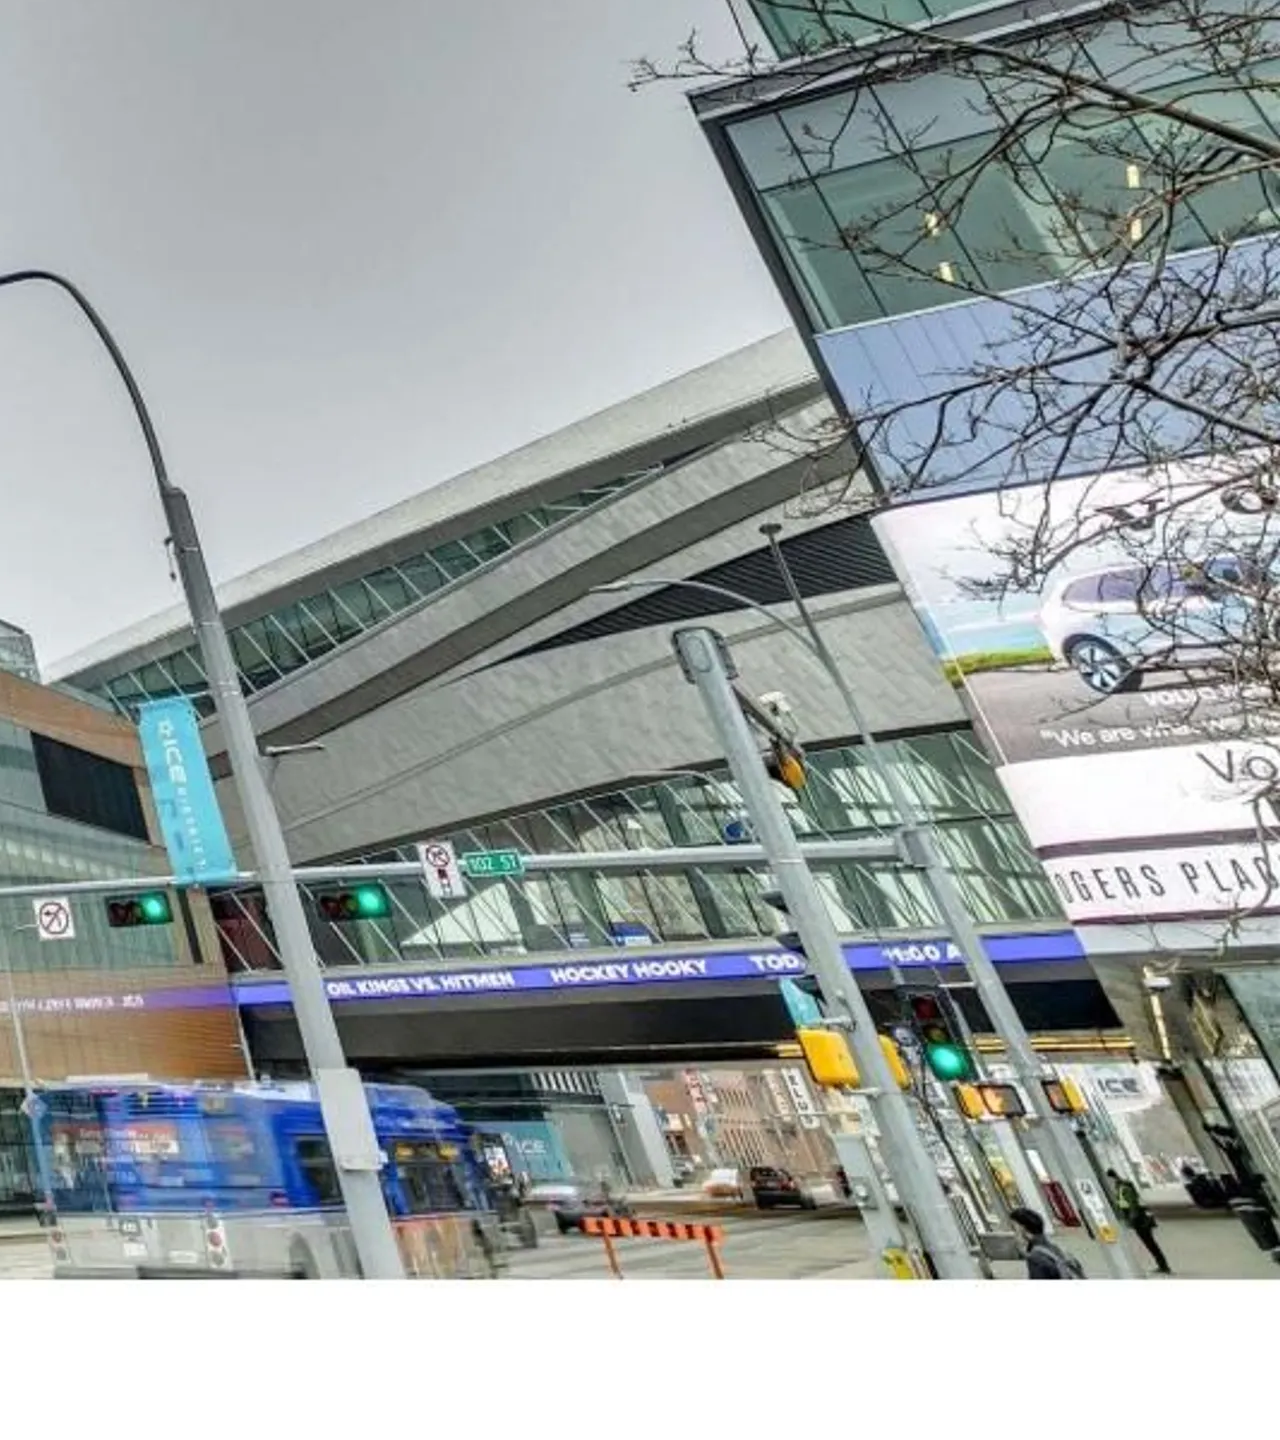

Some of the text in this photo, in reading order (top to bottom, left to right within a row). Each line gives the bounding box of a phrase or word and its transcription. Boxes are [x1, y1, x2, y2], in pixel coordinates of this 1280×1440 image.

[1099, 727, 1136, 743] are
[500, 854, 517, 870] ST
[327, 979, 356, 996] OIL
[358, 976, 409, 994] KINGS
[441, 971, 516, 991] HITMEN
[550, 964, 629, 984] HOCKEY
[633, 959, 707, 979] HOOKY
